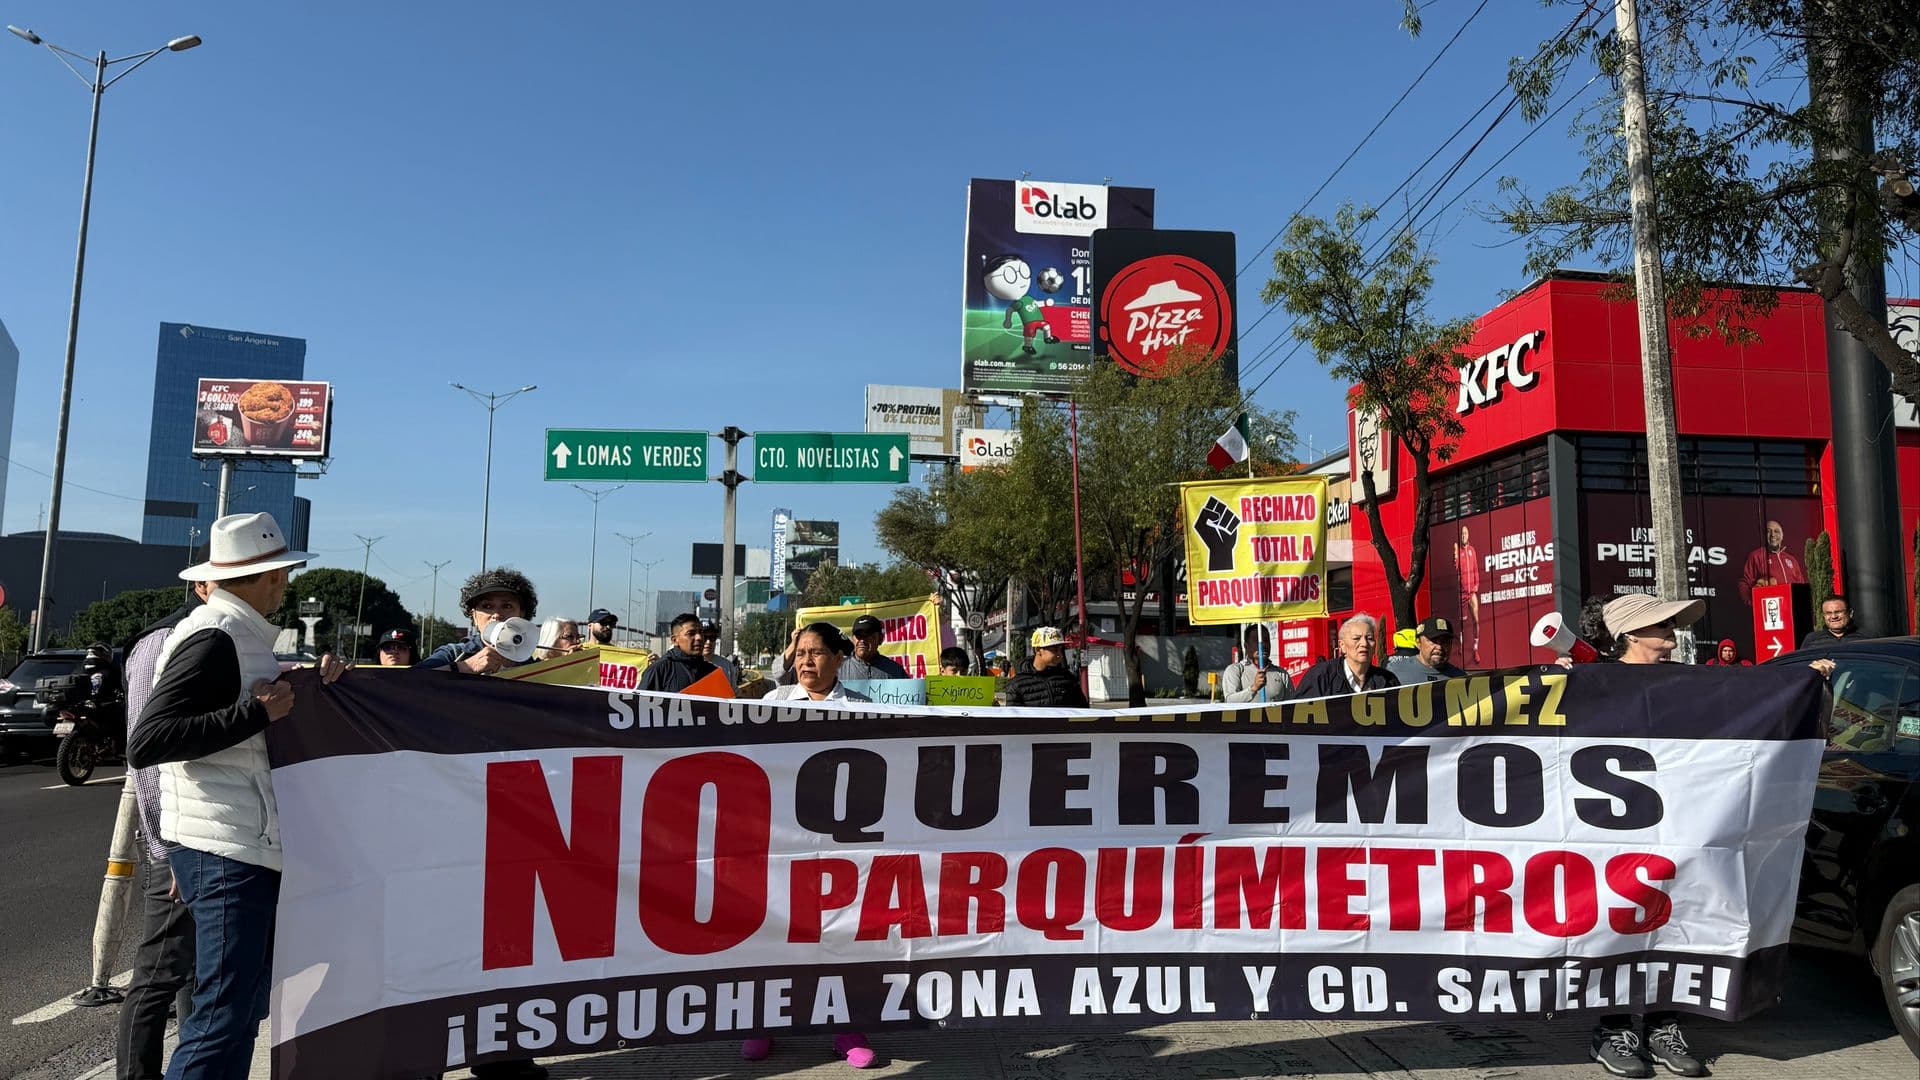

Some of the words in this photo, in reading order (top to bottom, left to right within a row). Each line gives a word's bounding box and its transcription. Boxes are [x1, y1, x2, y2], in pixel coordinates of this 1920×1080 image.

[1126, 306, 1204, 343] Pizza
[1140, 325, 1195, 355] Hut
[1456, 331, 1541, 413] KFC
[200, 391, 207, 402] 3
[207, 393, 239, 403] GOLAZOS
[211, 385, 230, 393] KFC
[203, 402, 212, 410] DE
[213, 402, 234, 411] SABOR
[897, 404, 941, 416] PROTEÍNA
[900, 415, 940, 425] LACTOSA
[577, 445, 632, 466] LOMAS
[643, 446, 702, 467] VERDES
[760, 448, 788, 468] CTO.
[798, 448, 879, 468] NOVELISTAS
[1241, 494, 1317, 523] RECHAZO
[1327, 498, 1349, 525] cken
[1251, 536, 1300, 562] TOTAL
[1301, 535, 1314, 560] A
[1485, 542, 1554, 572] PIERNAS
[1597, 543, 1728, 565] PIERAS
[1198, 571, 1321, 606] PARQUÍMETROS
[882, 615, 927, 642] HAZO
[929, 680, 984, 702] Exigimos
[608, 691, 706, 729] SRA.
[796, 742, 1664, 844] QUEREMOS
[483, 751, 771, 970] NO
[789, 833, 1676, 943] PARQUÍMETROS
[446, 977, 793, 1068] ¡ESCUCHE
[811, 975, 851, 1025] A
[881, 968, 1042, 1021] ZONA
[1069, 966, 1217, 1015] AZUL
[1241, 966, 1277, 1013] Y
[1307, 966, 1408, 1014] CD.
[1437, 960, 1732, 1014] SATÉLITE!
